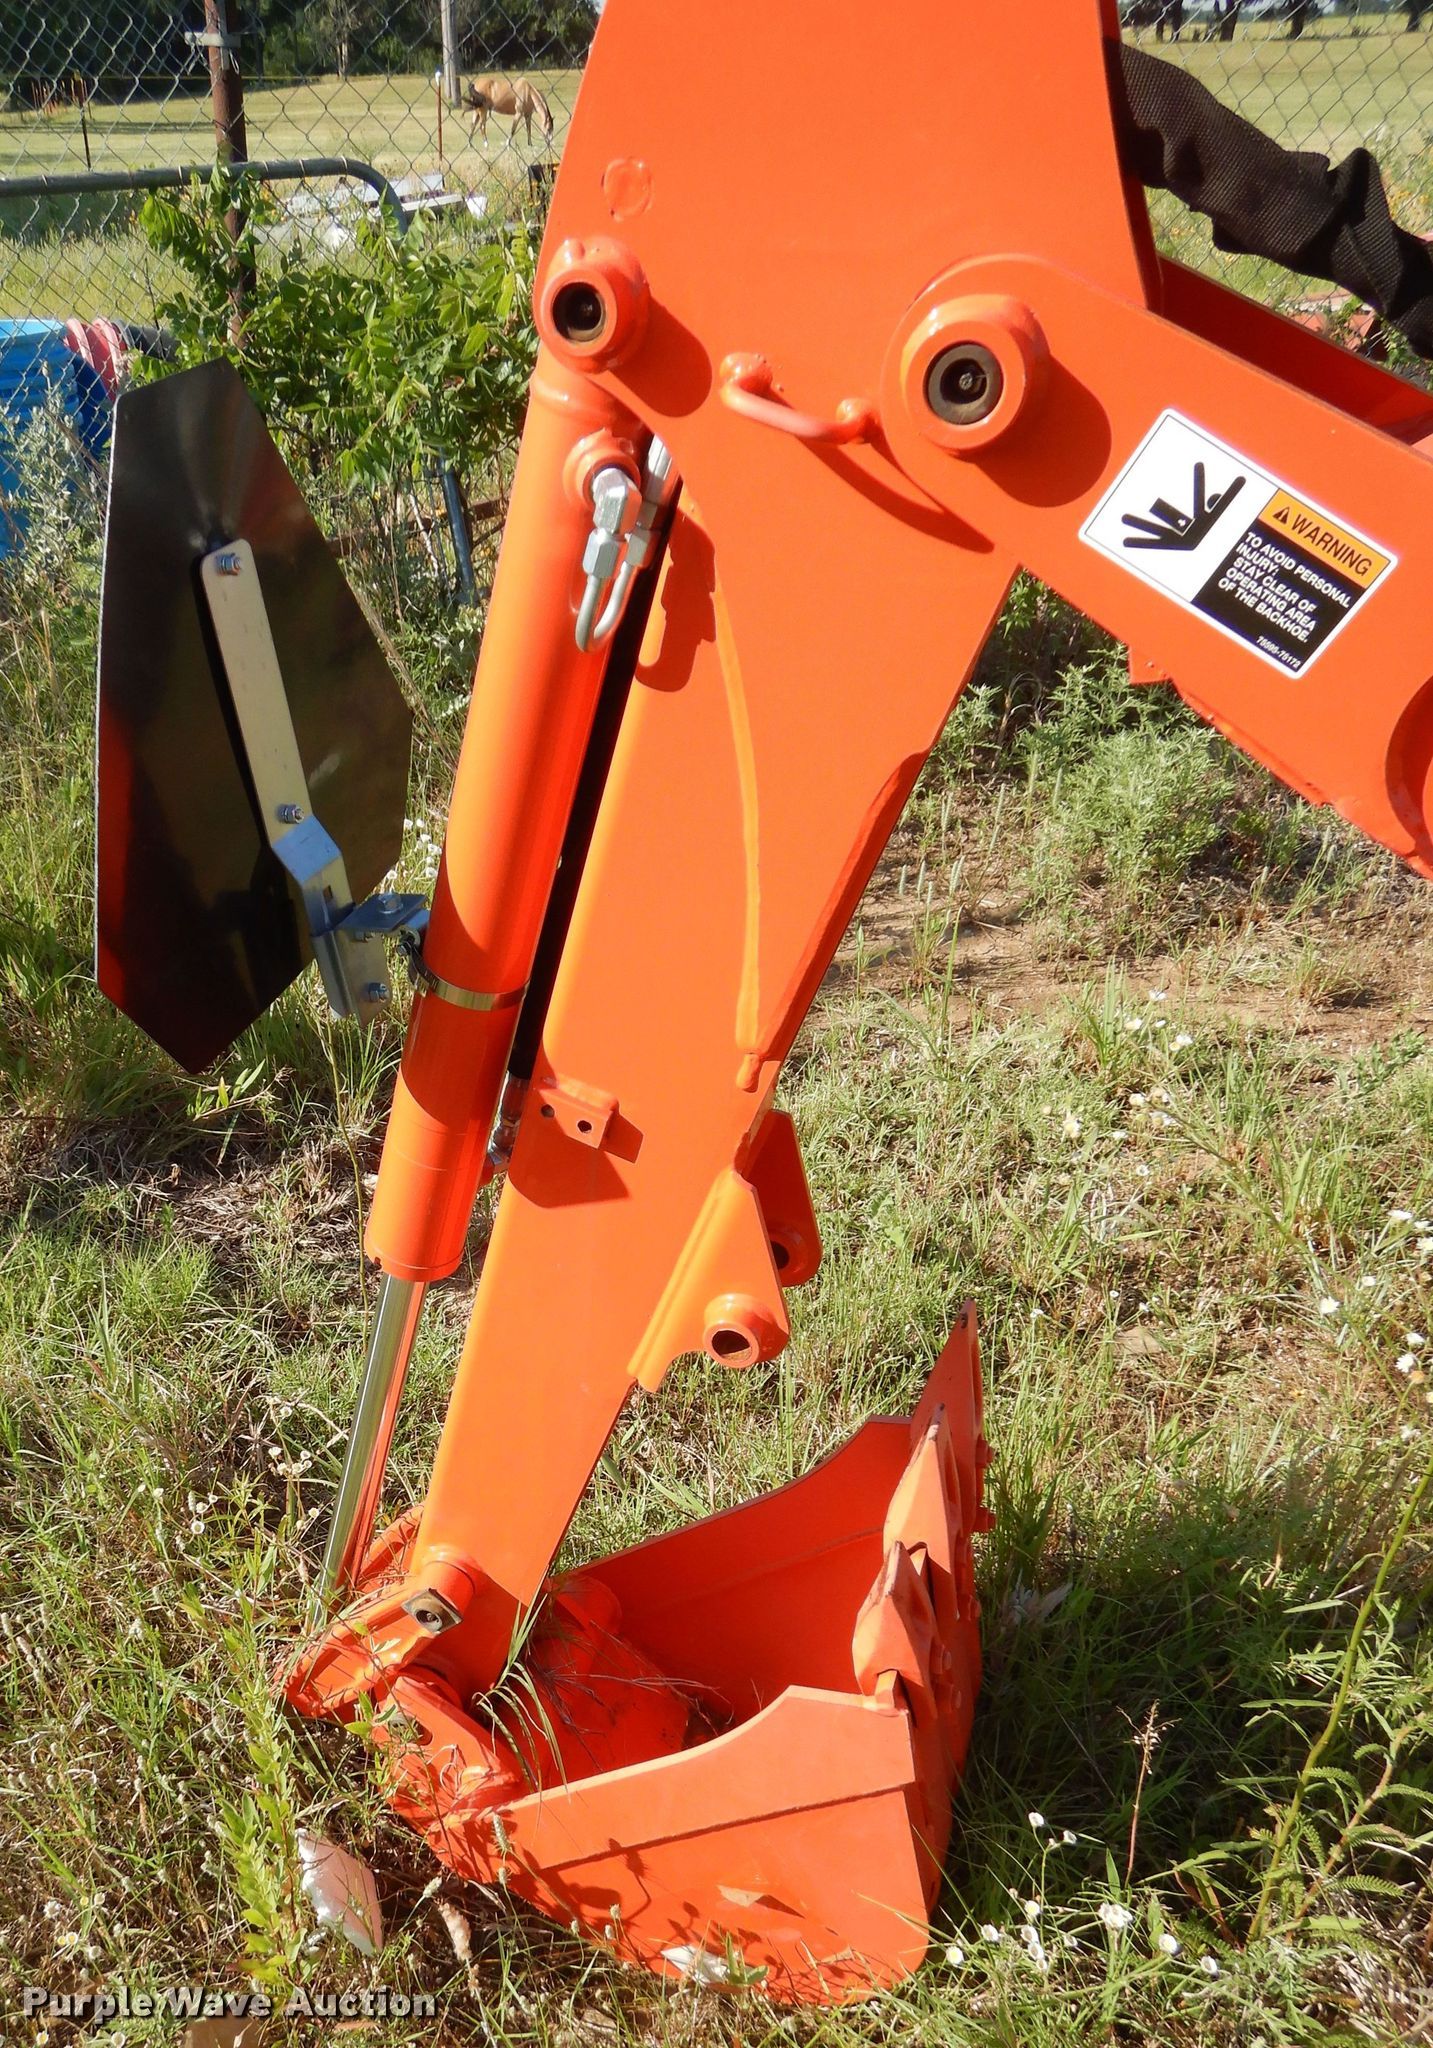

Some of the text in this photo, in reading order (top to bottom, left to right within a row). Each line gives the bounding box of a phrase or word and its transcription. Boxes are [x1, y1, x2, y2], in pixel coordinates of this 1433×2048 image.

[1236, 542, 1279, 576] INJURY:
[1245, 531, 1351, 608] TO AVOID PERSONAL
[1292, 513, 1372, 577] WARNING
[1218, 577, 1310, 643] OF THE BACKHOE.
[1226, 567, 1316, 632] OPERATING AREA
[1233, 556, 1317, 613] STAY CLEAR OF
